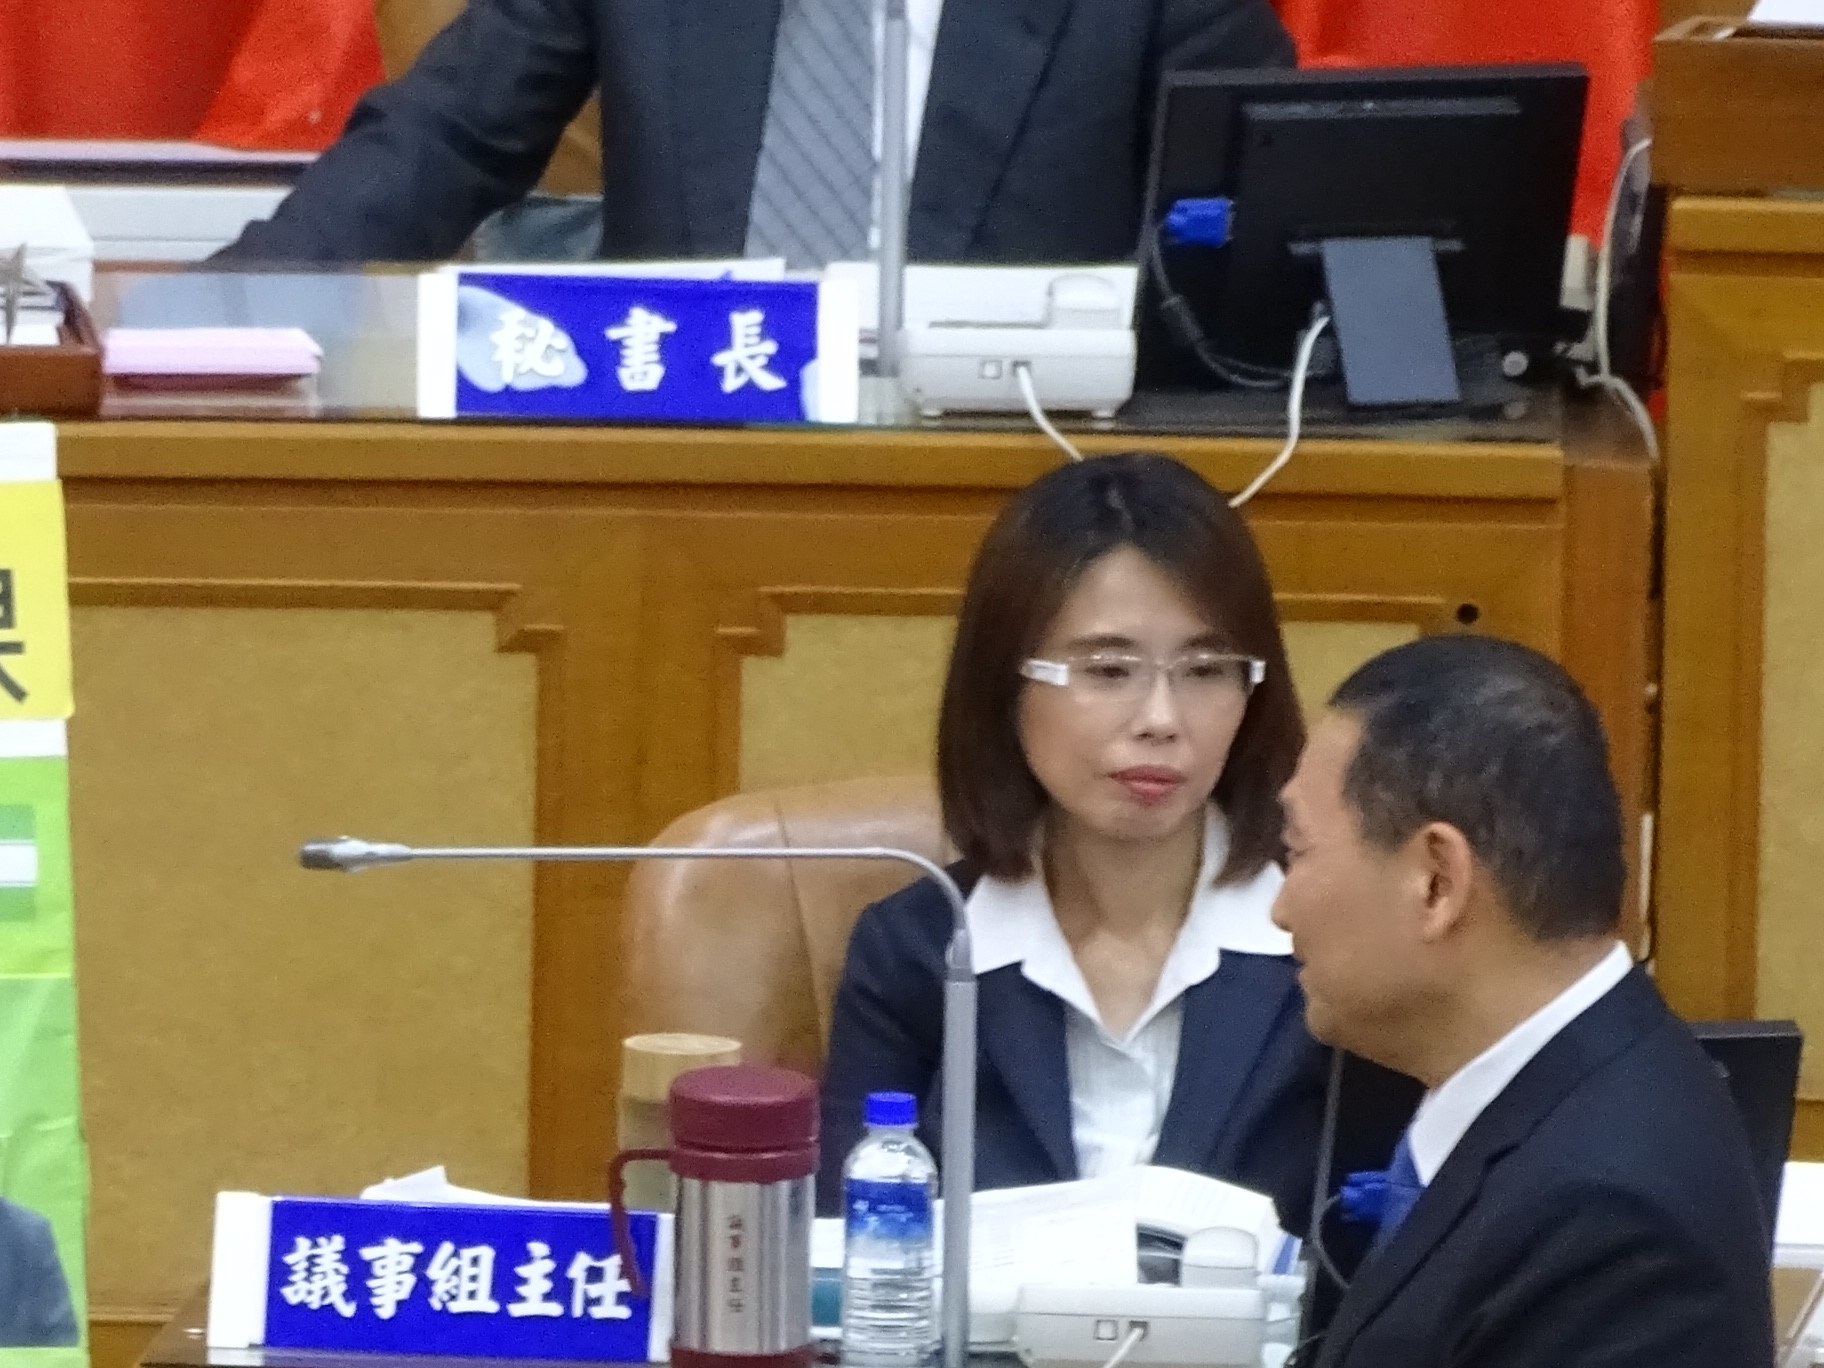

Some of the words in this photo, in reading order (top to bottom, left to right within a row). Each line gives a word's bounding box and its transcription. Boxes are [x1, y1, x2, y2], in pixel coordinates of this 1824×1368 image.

[280, 1234, 633, 1320] 議事組主任
